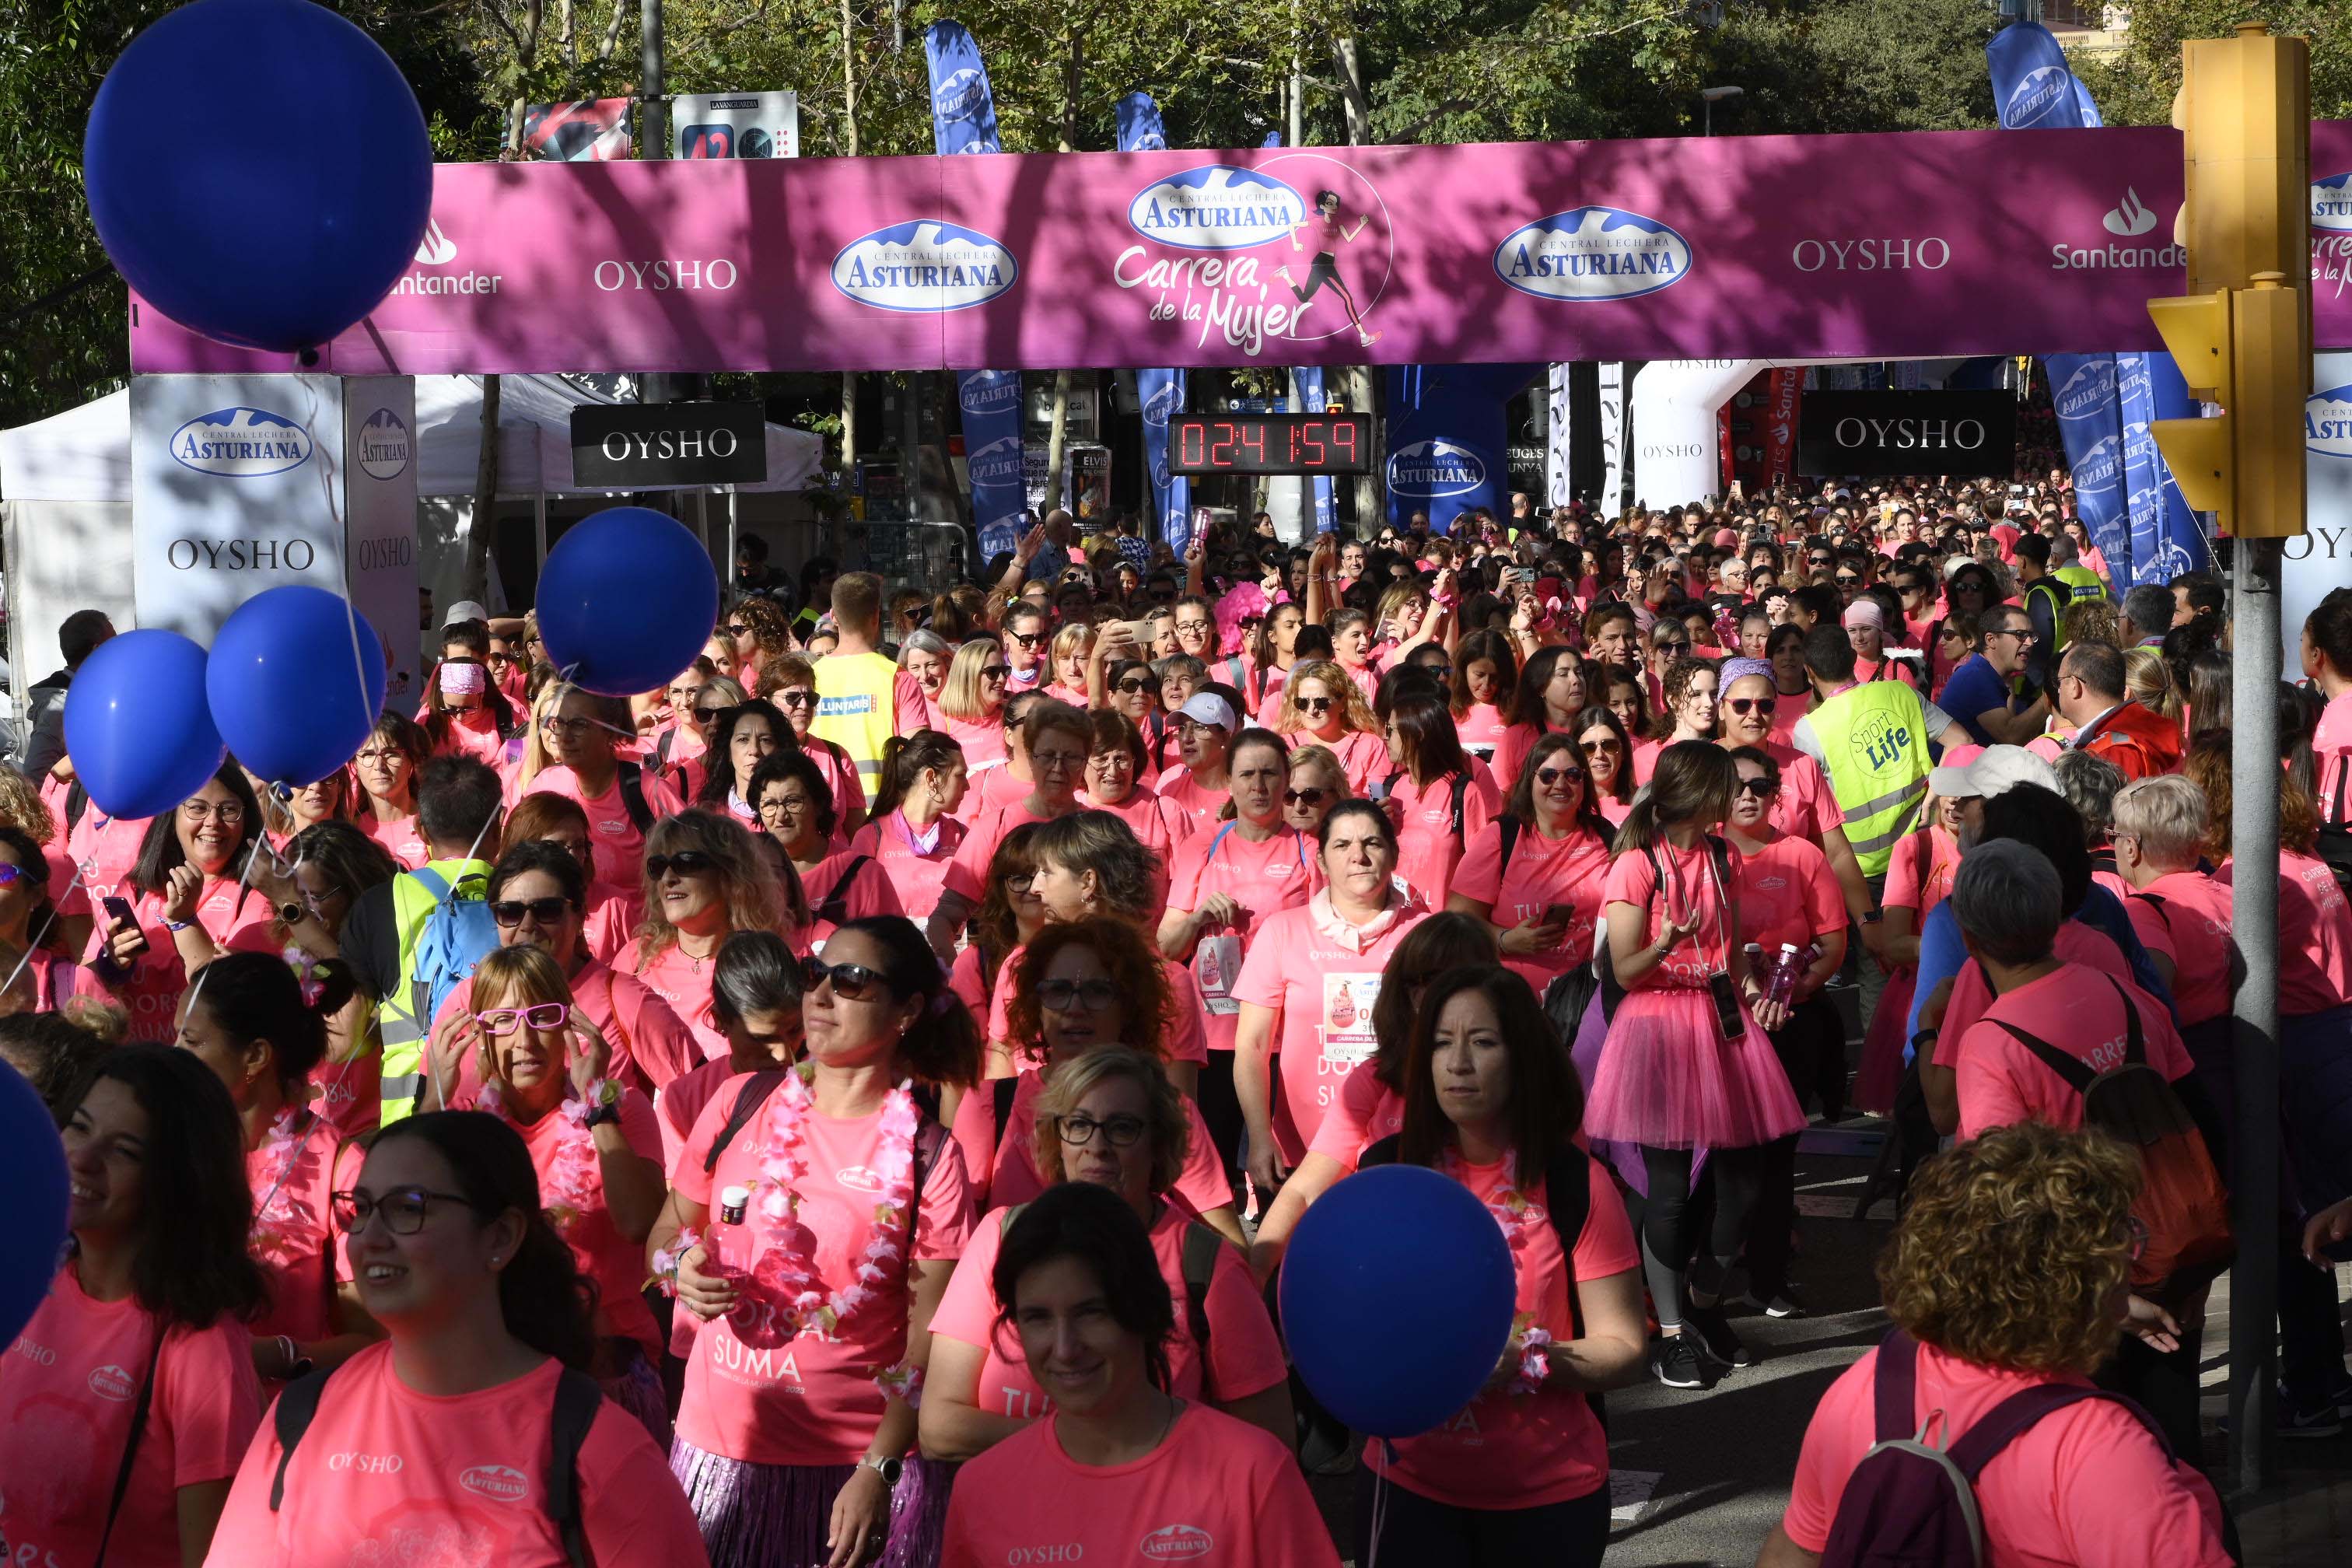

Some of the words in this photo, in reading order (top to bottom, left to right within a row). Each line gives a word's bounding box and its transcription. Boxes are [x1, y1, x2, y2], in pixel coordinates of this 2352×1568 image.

[1142, 197, 1292, 229] ASTURIANA
[874, 252, 933, 261] CENTRAL
[939, 250, 996, 260] LECHERA
[1539, 240, 1599, 249] CENTRAL
[1607, 238, 1669, 247] LECHERA
[1793, 237, 1950, 271] OYSHO
[2052, 243, 2187, 270] Santande
[594, 259, 737, 291] OYSHO
[845, 254, 1003, 288] ASTURIANA
[1114, 246, 1259, 289] Carrera
[1508, 243, 1676, 278] ASTURIANA
[390, 271, 502, 295] ntander
[1149, 291, 1176, 320] de
[1182, 289, 1202, 320] la
[1197, 283, 1314, 356] Mujer
[180, 432, 303, 460] ASTURIANA
[201, 431, 247, 439] CENTRAL
[602, 429, 737, 460] OYSHO
[1836, 417, 1985, 450] OYSHO
[1083, 456, 1108, 466] ELVIS
[1643, 443, 1703, 460] OYSHO
[1391, 467, 1479, 485] ASTURIANA
[167, 539, 314, 570] OYSHO
[1850, 711, 1892, 754] Sport
[1866, 726, 1911, 772] Life
[714, 1334, 802, 1383] SUMA
[328, 1452, 403, 1473] OYSHO
[466, 1472, 527, 1494] ASTURIANA
[1008, 1543, 1083, 1566] OYSHO
[1146, 1540, 1208, 1554] ASTURIANA
